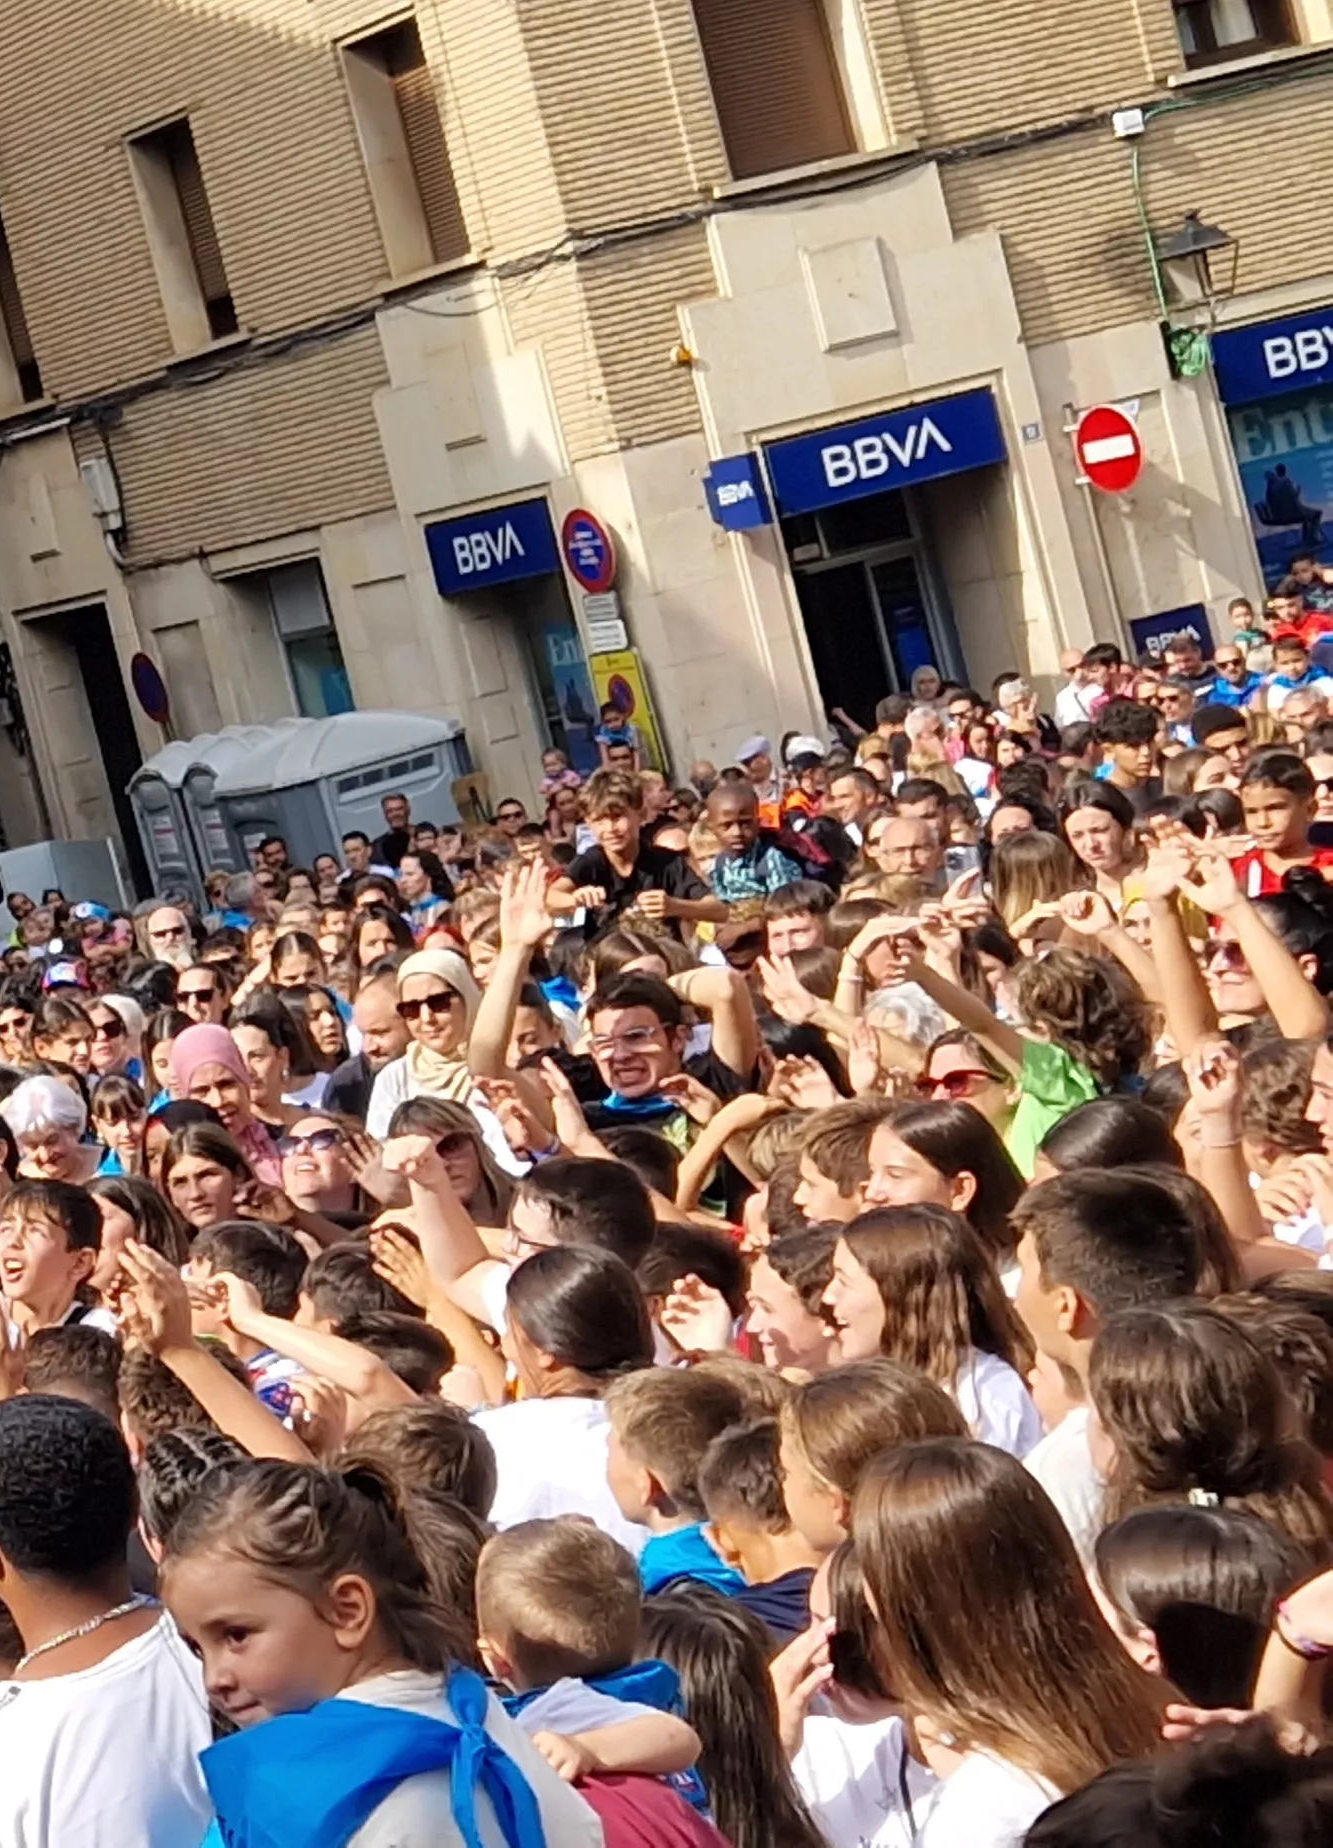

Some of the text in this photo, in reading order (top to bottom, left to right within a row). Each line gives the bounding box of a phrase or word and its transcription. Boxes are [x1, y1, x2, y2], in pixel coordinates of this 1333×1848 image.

[1263, 325, 1333, 379] BB
[820, 417, 953, 487] BBVA
[717, 480, 754, 506] BBVA
[452, 521, 526, 575] BBVA
